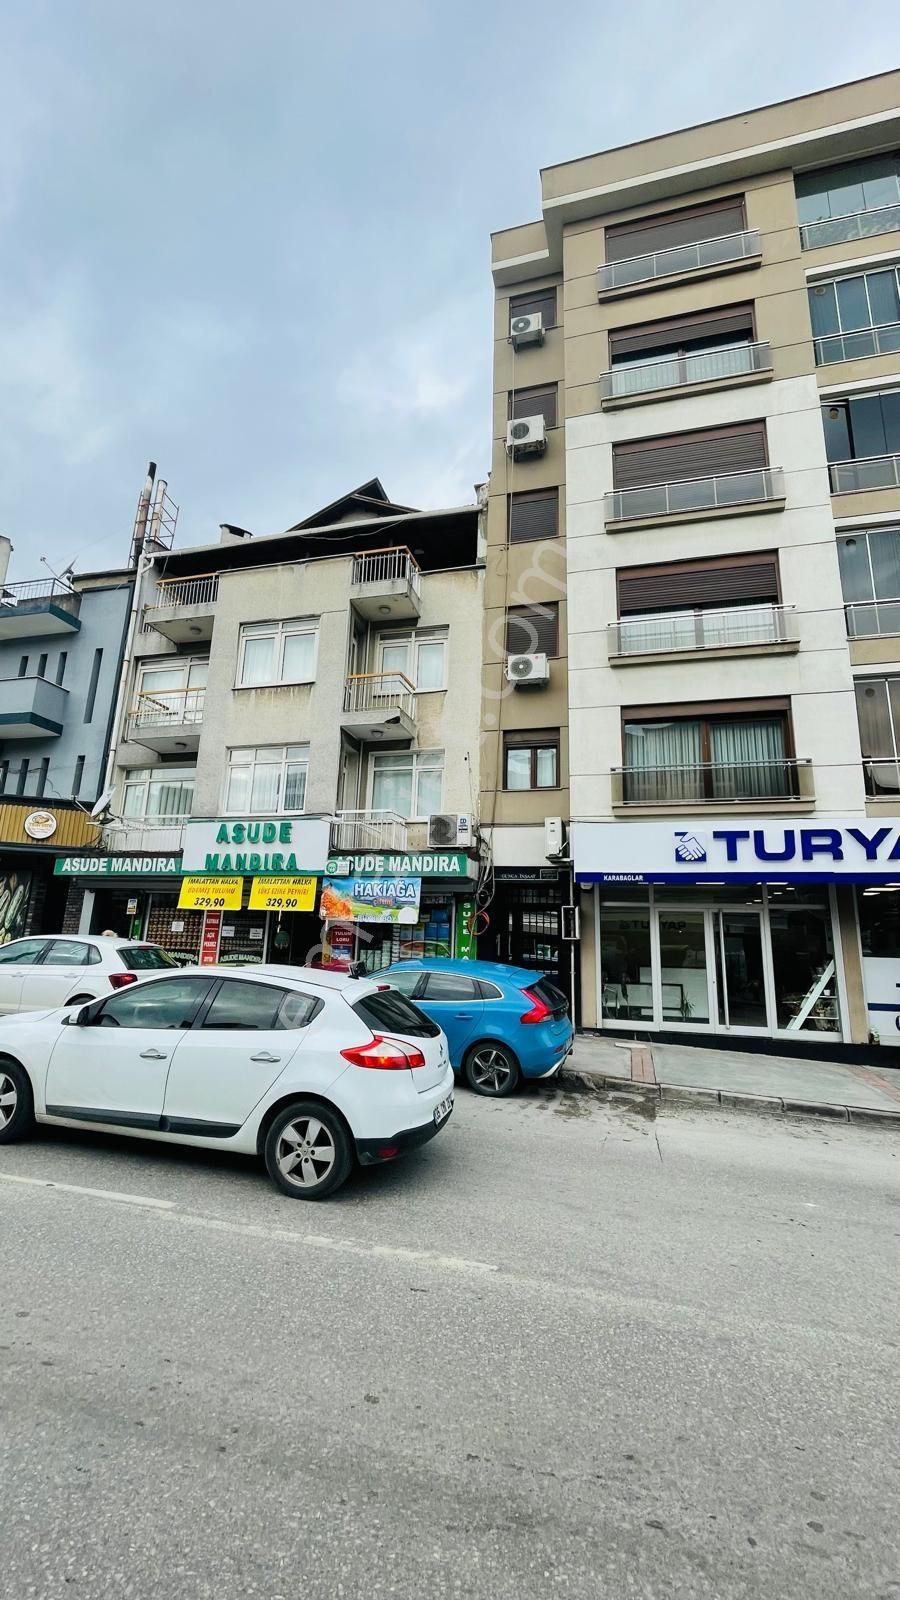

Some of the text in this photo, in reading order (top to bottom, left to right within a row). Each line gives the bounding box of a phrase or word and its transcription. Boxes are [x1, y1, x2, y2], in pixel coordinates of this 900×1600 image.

[215, 822, 293, 844] ASUDE
[713, 828, 900, 861] TURY
[62, 858, 176, 872] ASUDE MANDIRA
[204, 852, 298, 871] MANDIRA
[338, 856, 384, 872] SUDE
[388, 856, 460, 872] MANDIRA
[353, 880, 416, 898] HAKİAĞA
[194, 897, 225, 908] 329,90
[266, 898, 298, 908] 329,90
[631, 920, 687, 930] TUYAP
